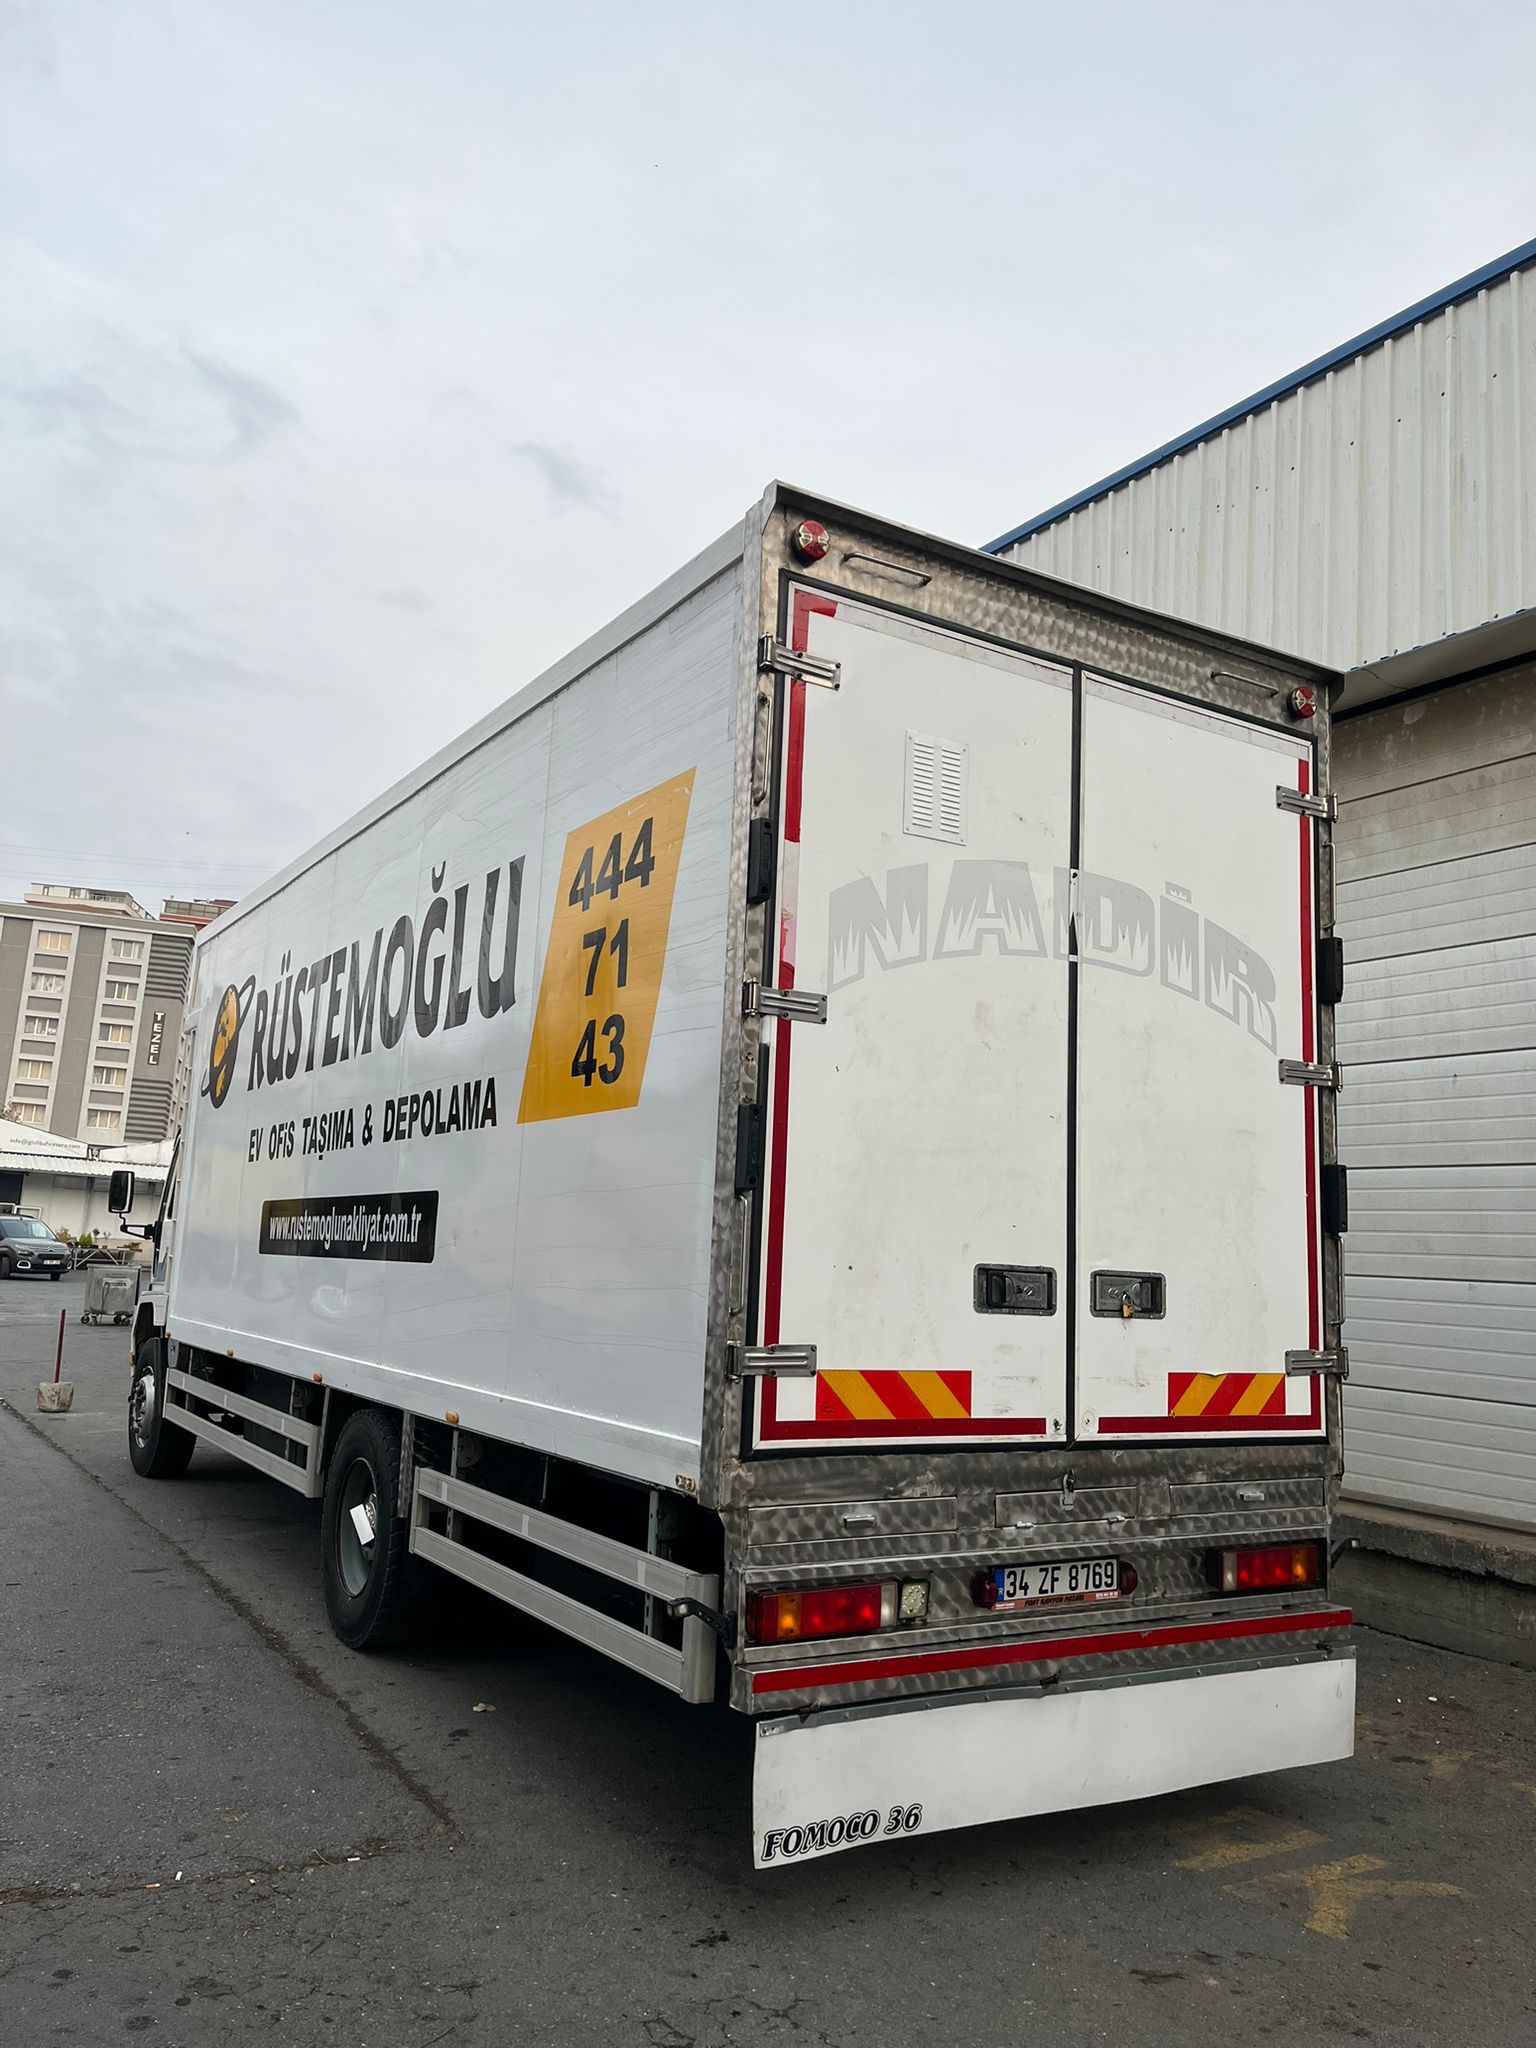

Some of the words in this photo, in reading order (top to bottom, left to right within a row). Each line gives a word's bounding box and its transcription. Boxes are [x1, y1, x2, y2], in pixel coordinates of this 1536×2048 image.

[569, 816, 656, 912] 444
[247, 854, 526, 1091] RÜSTEMOĞLU
[582, 917, 629, 997] 71
[828, 859, 1278, 1056] NADİR
[148, 1011, 165, 1064] TEZEL
[571, 1013, 625, 1088] 43
[248, 1128, 264, 1163] EV
[302, 1108, 354, 1160] TAŞIMA
[361, 1103, 373, 1146] &
[383, 1077, 497, 1143] DEPOLAMA
[269, 1204, 422, 1252] www.rustemoglunakliyat.com.tr
[1006, 1569, 1029, 1598] 34
[1038, 1566, 1061, 1594] ZF
[1068, 1561, 1114, 1591] 8769
[884, 1803, 923, 1835] 36
